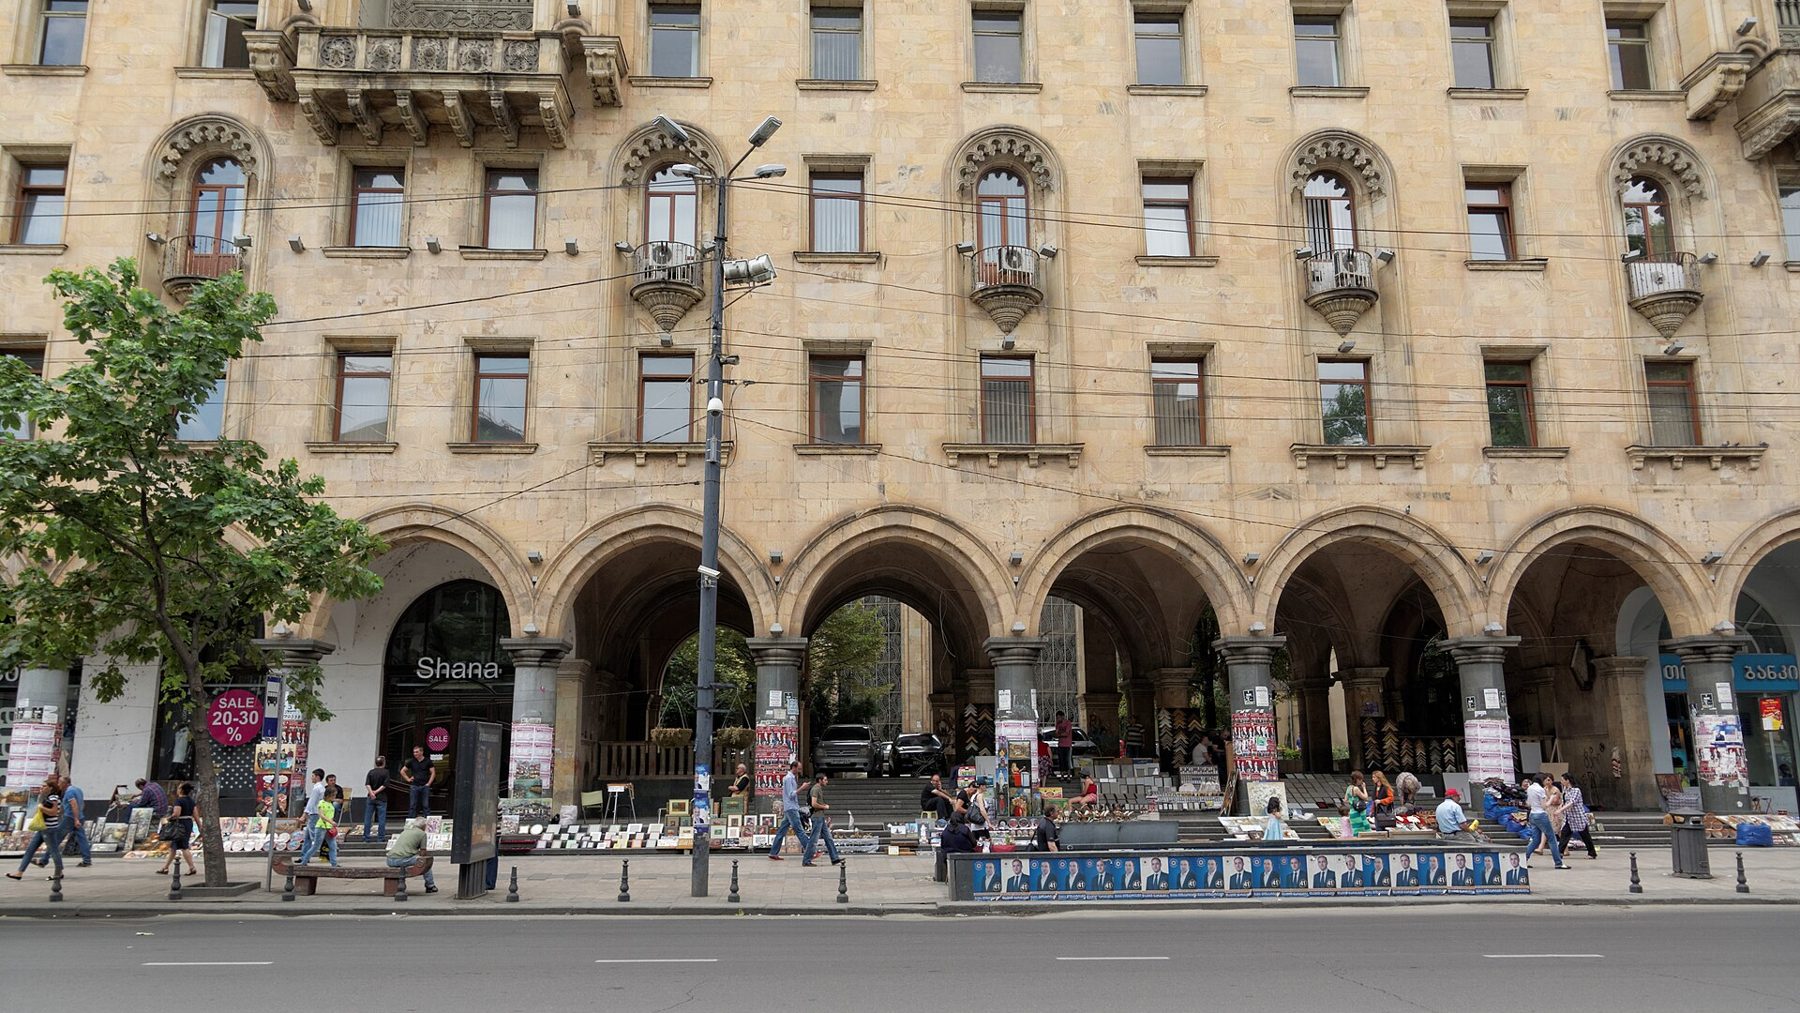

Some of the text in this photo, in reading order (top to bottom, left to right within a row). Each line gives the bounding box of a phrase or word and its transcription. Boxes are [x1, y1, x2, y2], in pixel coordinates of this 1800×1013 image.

[416, 656, 499, 679] Shana
[1743, 664, 1798, 680] ბანკი
[218, 697, 255, 709] SALE
[212, 710, 259, 726] 20-30
[226, 727, 242, 741] %
[428, 735, 448, 743] SALE
